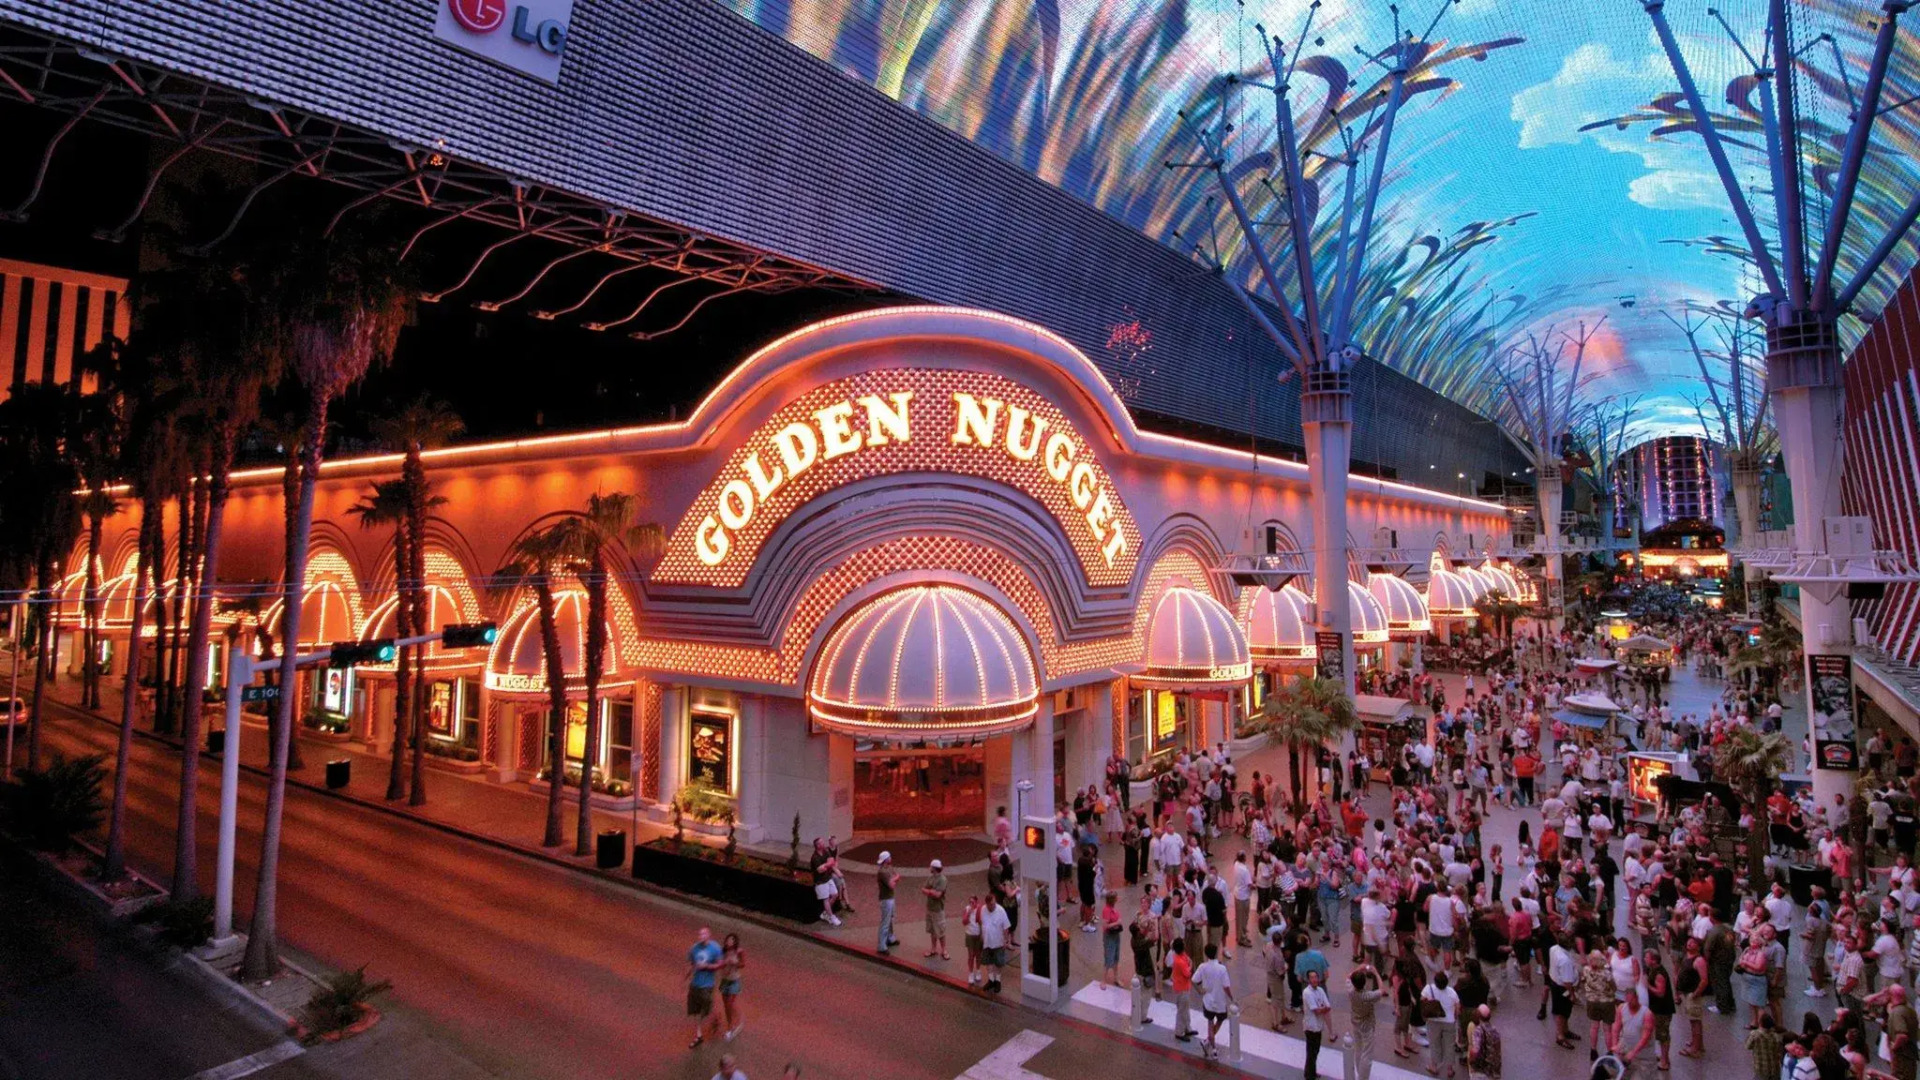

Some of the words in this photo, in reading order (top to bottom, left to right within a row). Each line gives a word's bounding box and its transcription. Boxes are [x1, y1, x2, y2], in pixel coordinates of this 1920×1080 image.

[511, 5, 567, 55] LG
[695, 391, 914, 566] GOLDEN
[952, 391, 1127, 570] NUGGET
[249, 689, 257, 699] E
